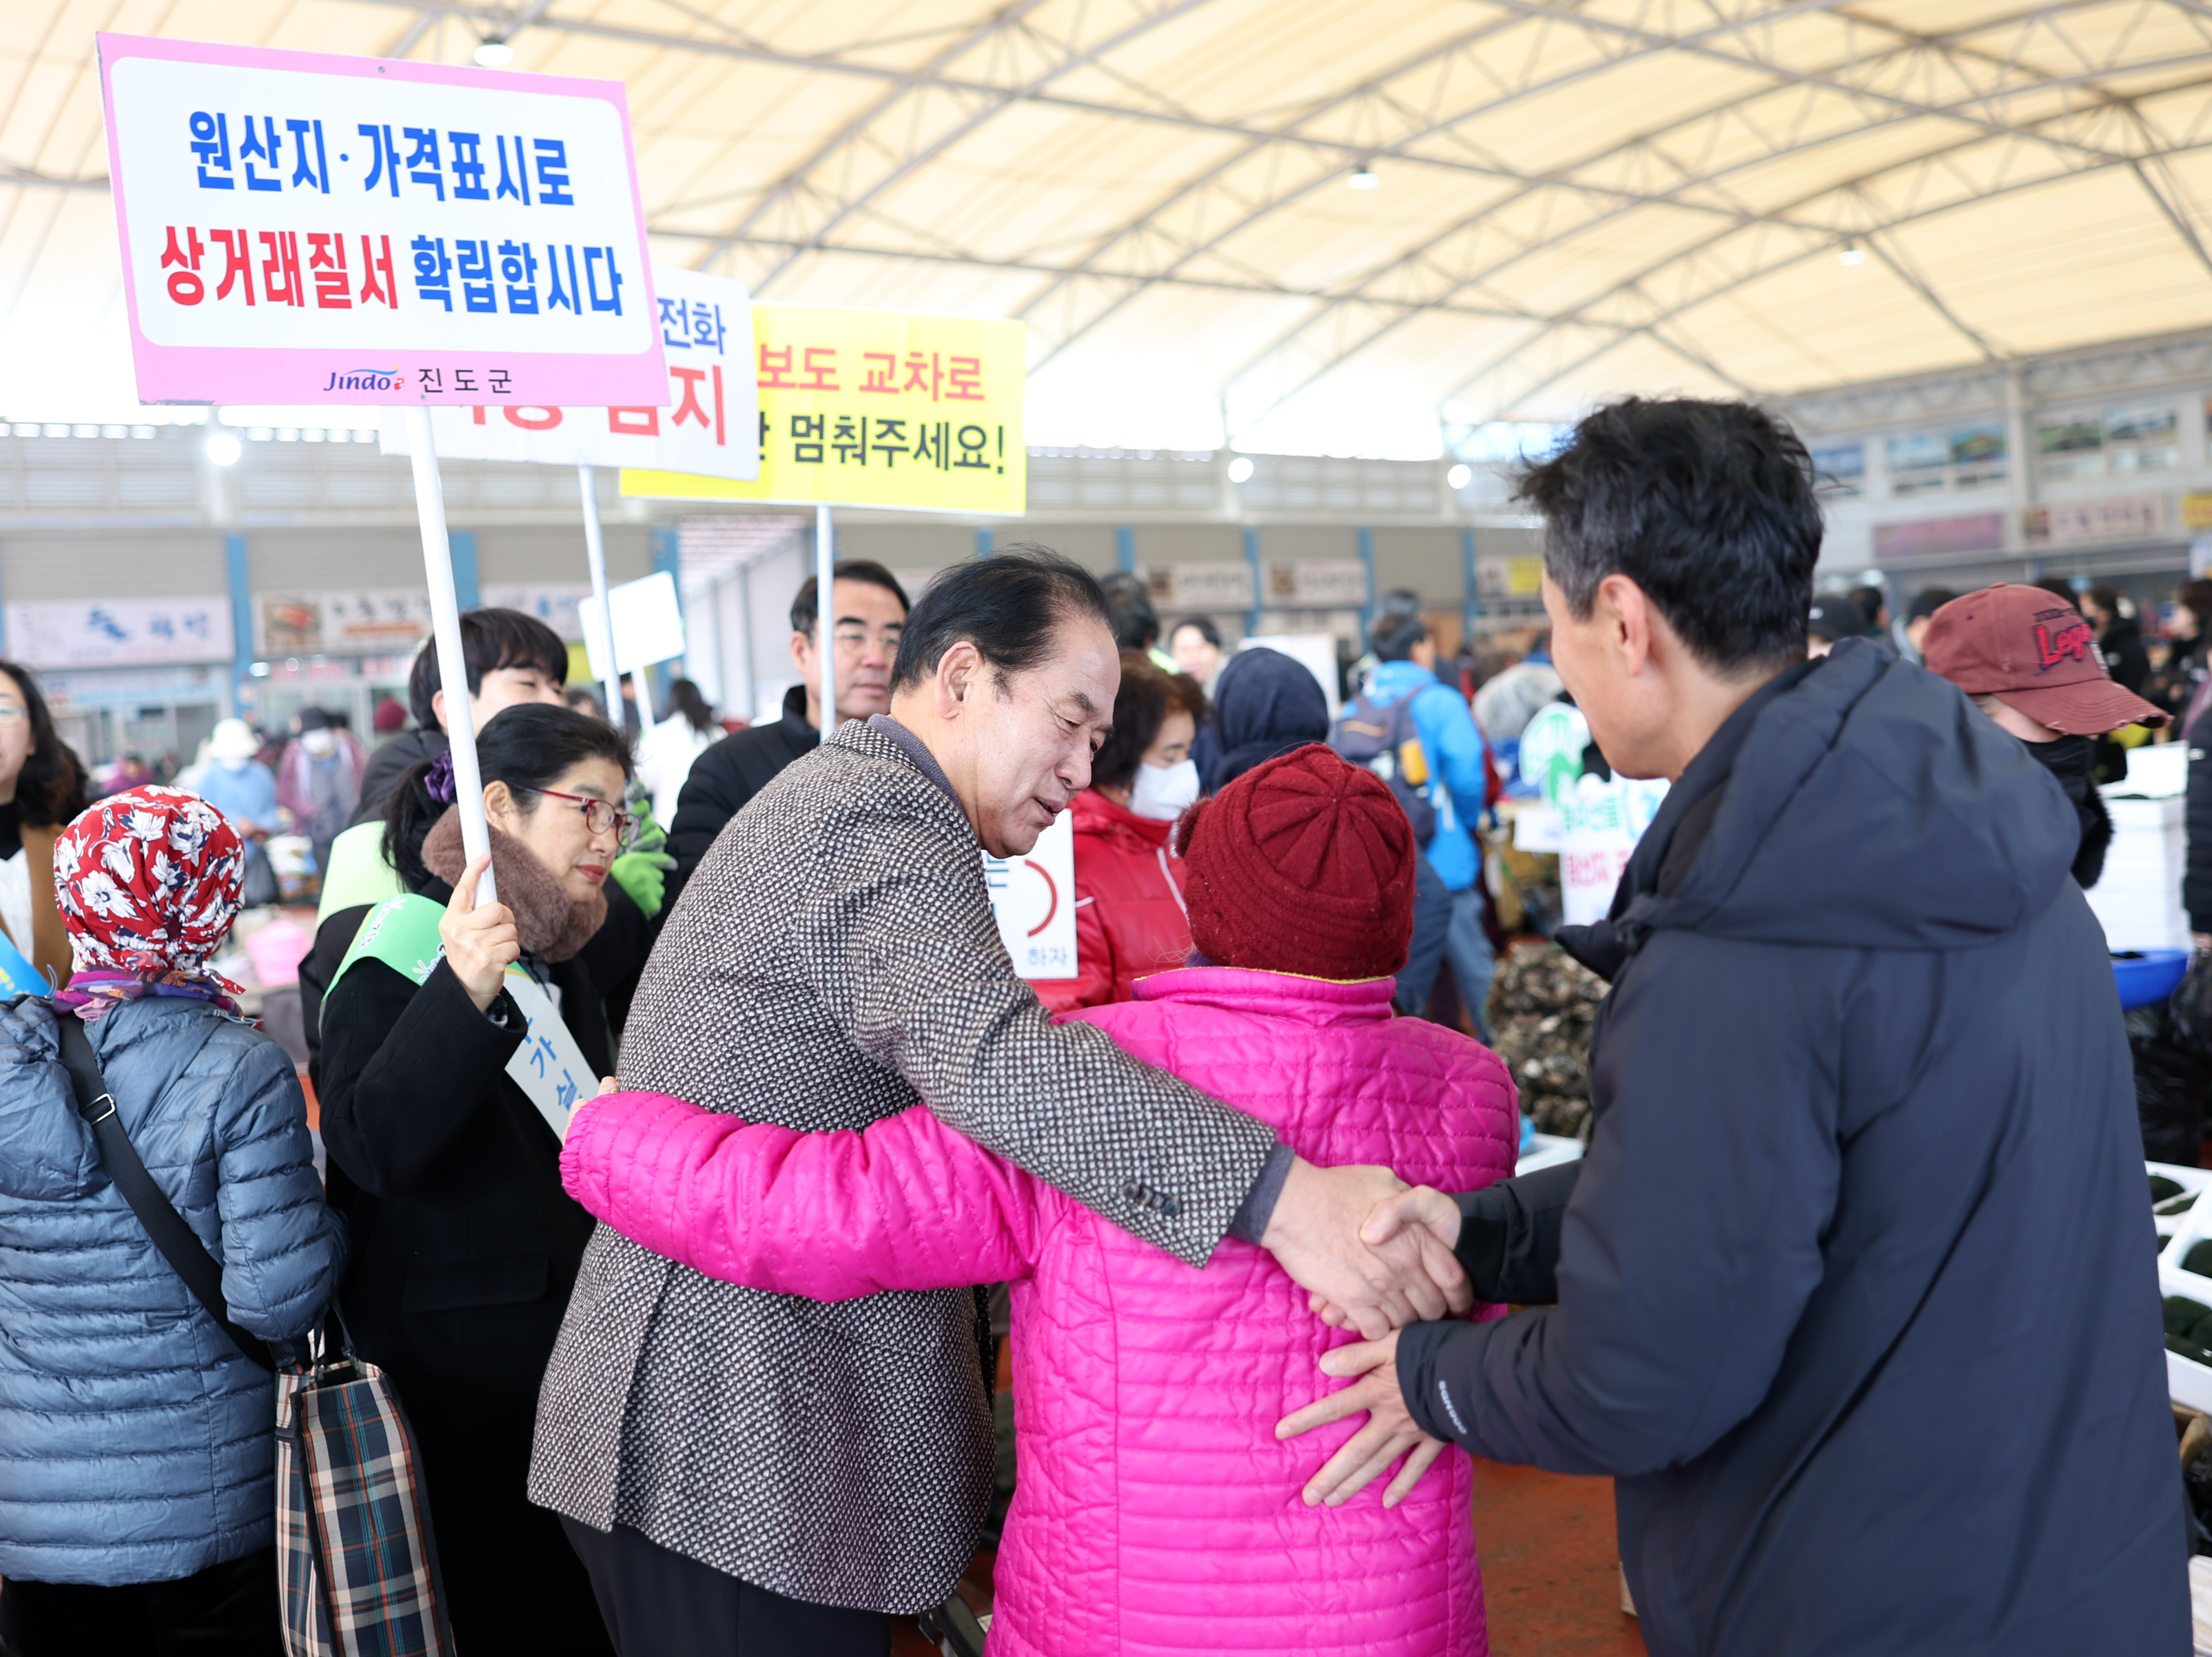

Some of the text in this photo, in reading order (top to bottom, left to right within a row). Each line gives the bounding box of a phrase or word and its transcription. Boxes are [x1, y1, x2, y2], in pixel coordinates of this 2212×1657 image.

[161, 225, 623, 316] 상거래질서 확립합시다
[323, 371, 391, 392] Jindo
[418, 367, 512, 394] 진도군
[859, 349, 985, 402] 교차로
[791, 413, 1005, 475] 멈춰주세요!
